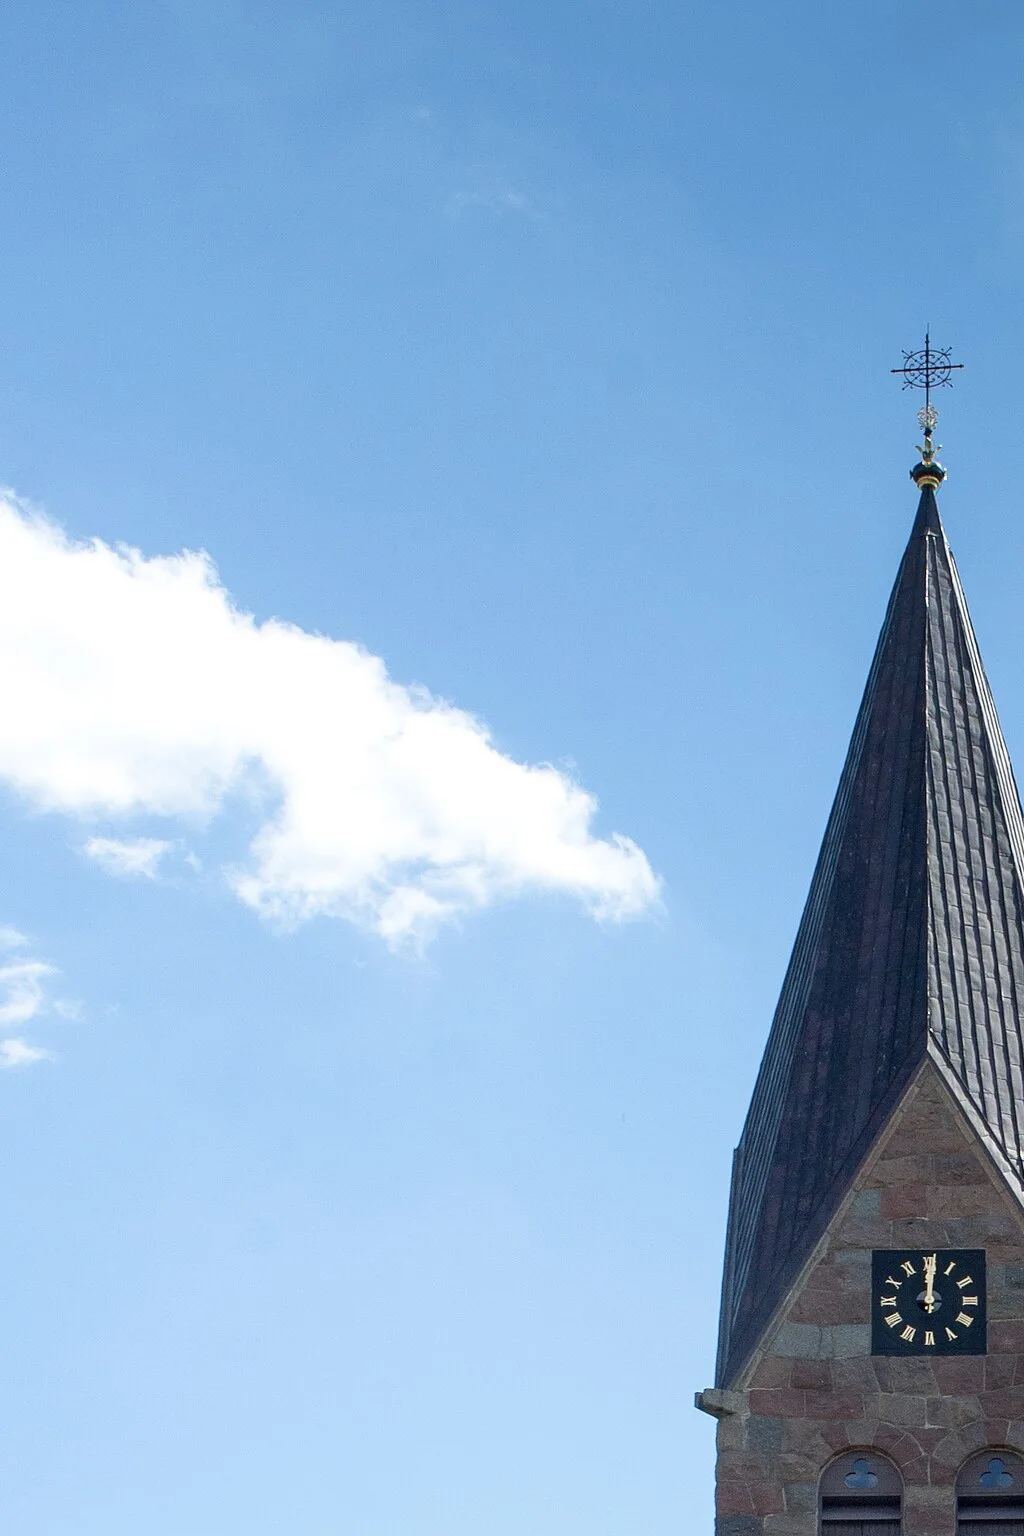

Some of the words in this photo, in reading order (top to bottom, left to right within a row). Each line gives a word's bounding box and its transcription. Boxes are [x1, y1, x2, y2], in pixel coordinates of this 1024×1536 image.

[900, 1261, 917, 1278] XI
[943, 1261, 956, 1276] I
[885, 1275, 902, 1290] X
[956, 1276, 973, 1289] II
[880, 1296, 897, 1306] IX
[962, 1296, 978, 1306] III
[884, 1312, 903, 1328] VIII
[955, 1311, 974, 1328] IIII
[900, 1325, 917, 1342] VII
[924, 1331, 936, 1346] VI
[944, 1327, 958, 1341] V
